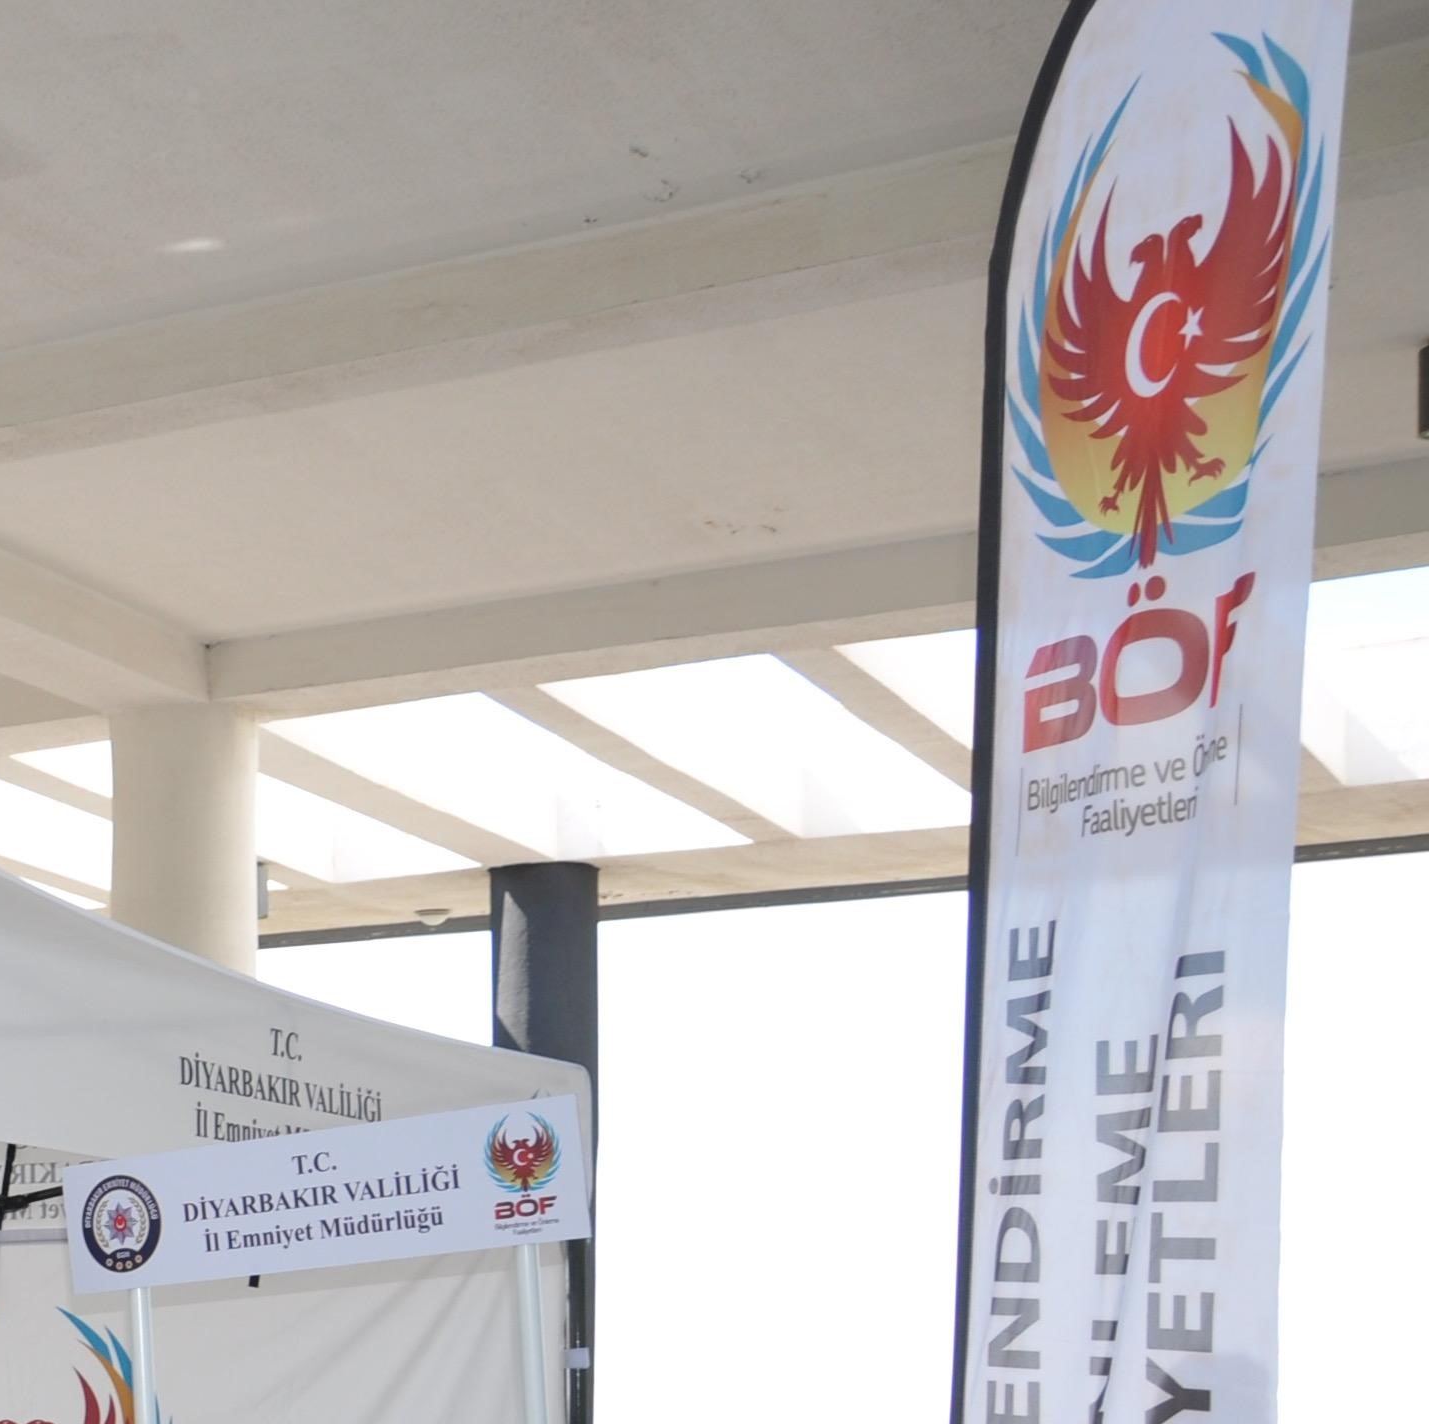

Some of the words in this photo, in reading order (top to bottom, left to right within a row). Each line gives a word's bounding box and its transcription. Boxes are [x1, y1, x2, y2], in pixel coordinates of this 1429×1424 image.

[1022, 571, 1256, 754] BÖF
[1027, 763, 1146, 814] Bilgilendirme
[1153, 757, 1186, 784] ve
[1081, 786, 1198, 838] Faaliyetleri
[270, 1028, 302, 1061] T.C.
[179, 1052, 301, 1108] DİYARBAKIR
[304, 1083, 382, 1123] VALİLİĞİ
[195, 1101, 208, 1138] İl
[292, 1151, 337, 1175] T.C.
[182, 1184, 339, 1223] DİYARBAKIR
[343, 1163, 461, 1202] VALİLİĞİ
[494, 1194, 557, 1220] BÖF
[204, 1228, 220, 1252] İl
[227, 1223, 313, 1250] Emniyet
[319, 1205, 444, 1240] Müdürlüğü
